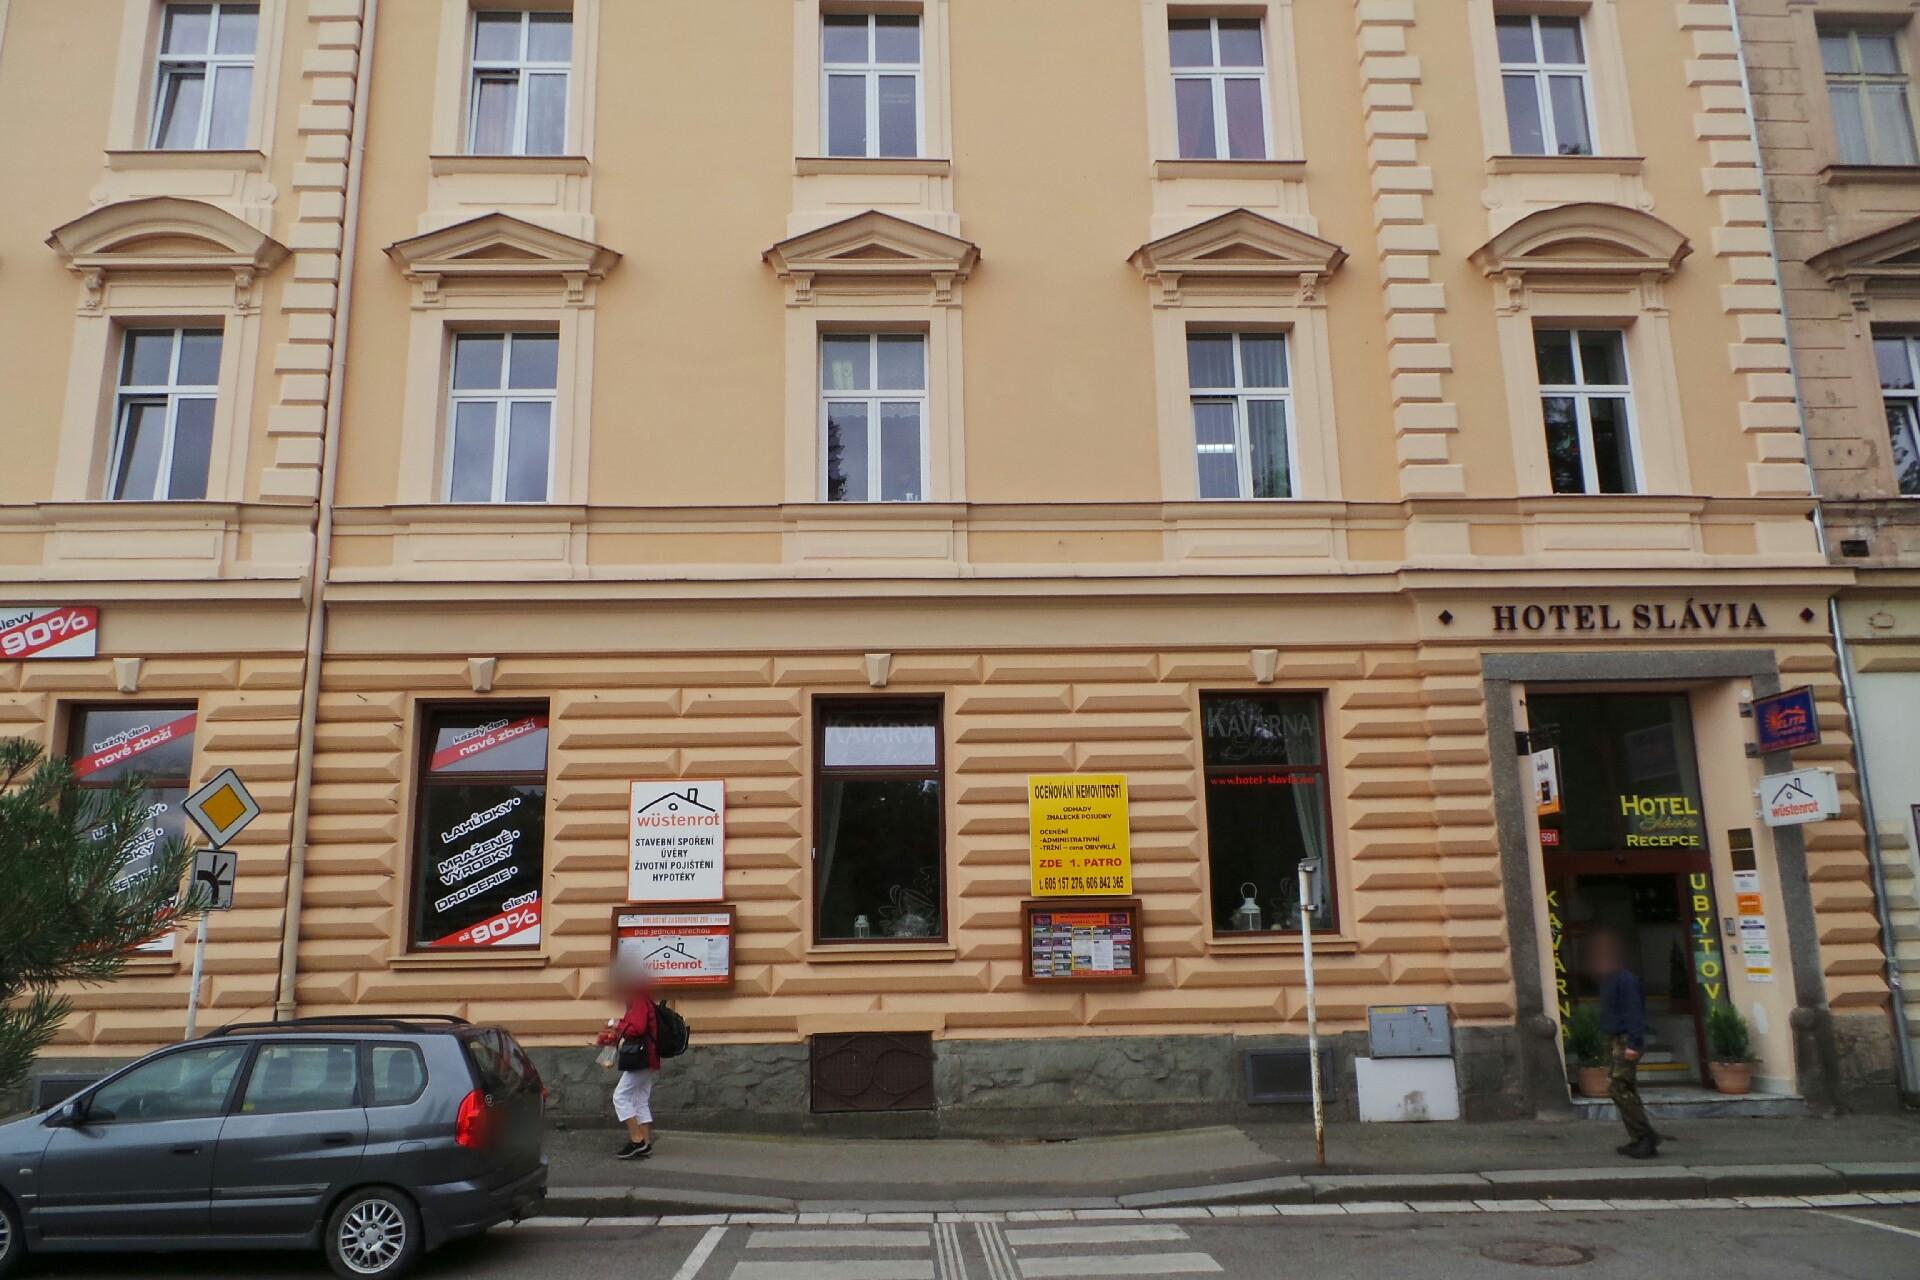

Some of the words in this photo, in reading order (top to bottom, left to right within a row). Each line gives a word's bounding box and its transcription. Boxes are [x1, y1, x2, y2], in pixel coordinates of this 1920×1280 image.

[1492, 604, 1620, 630] HOTEL
[1632, 597, 1767, 630] SLÁVIA
[1, 611, 88, 655] 90%
[93, 731, 128, 753] každý
[128, 725, 151, 739] den
[453, 725, 487, 745] každý
[487, 719, 509, 732] den
[460, 735, 496, 756] nové
[497, 719, 536, 741] zboží
[95, 744, 132, 767] nové
[134, 726, 172, 751] zboží
[1035, 781, 1074, 799] OCEŇOVÁNÍ
[1076, 780, 1122, 799] NEMOVITOSTÍ
[1620, 795, 1698, 816] HOTEL
[1771, 800, 1819, 818] wüstenrot
[441, 799, 513, 844] LAHŮDKY
[637, 812, 720, 827] wüstenrot
[635, 836, 675, 847] STAVEBNÍ
[677, 835, 714, 846] SPOŘENÍ
[1541, 833, 1556, 842] 591
[1626, 834, 1700, 847] RECEPCE
[438, 830, 514, 874] MRAŽENÉ
[635, 859, 668, 871] ŽIVOTNÍ
[670, 858, 714, 870] POJIŠTĚNÍ
[661, 847, 689, 858] ÚVĚRY
[1039, 859, 1063, 868] ZDE
[1070, 859, 1081, 868] 1.
[1084, 858, 1122, 867] PATRO
[440, 845, 513, 886] VÝROBKY
[652, 871, 696, 882] HYPOTÉKY
[435, 869, 512, 912] DROGERIE
[502, 890, 538, 911] slevy
[471, 909, 538, 944] 90%
[1690, 873, 1720, 1014] UBYTOV
[1547, 890, 1571, 1040] KAVÁRNA
